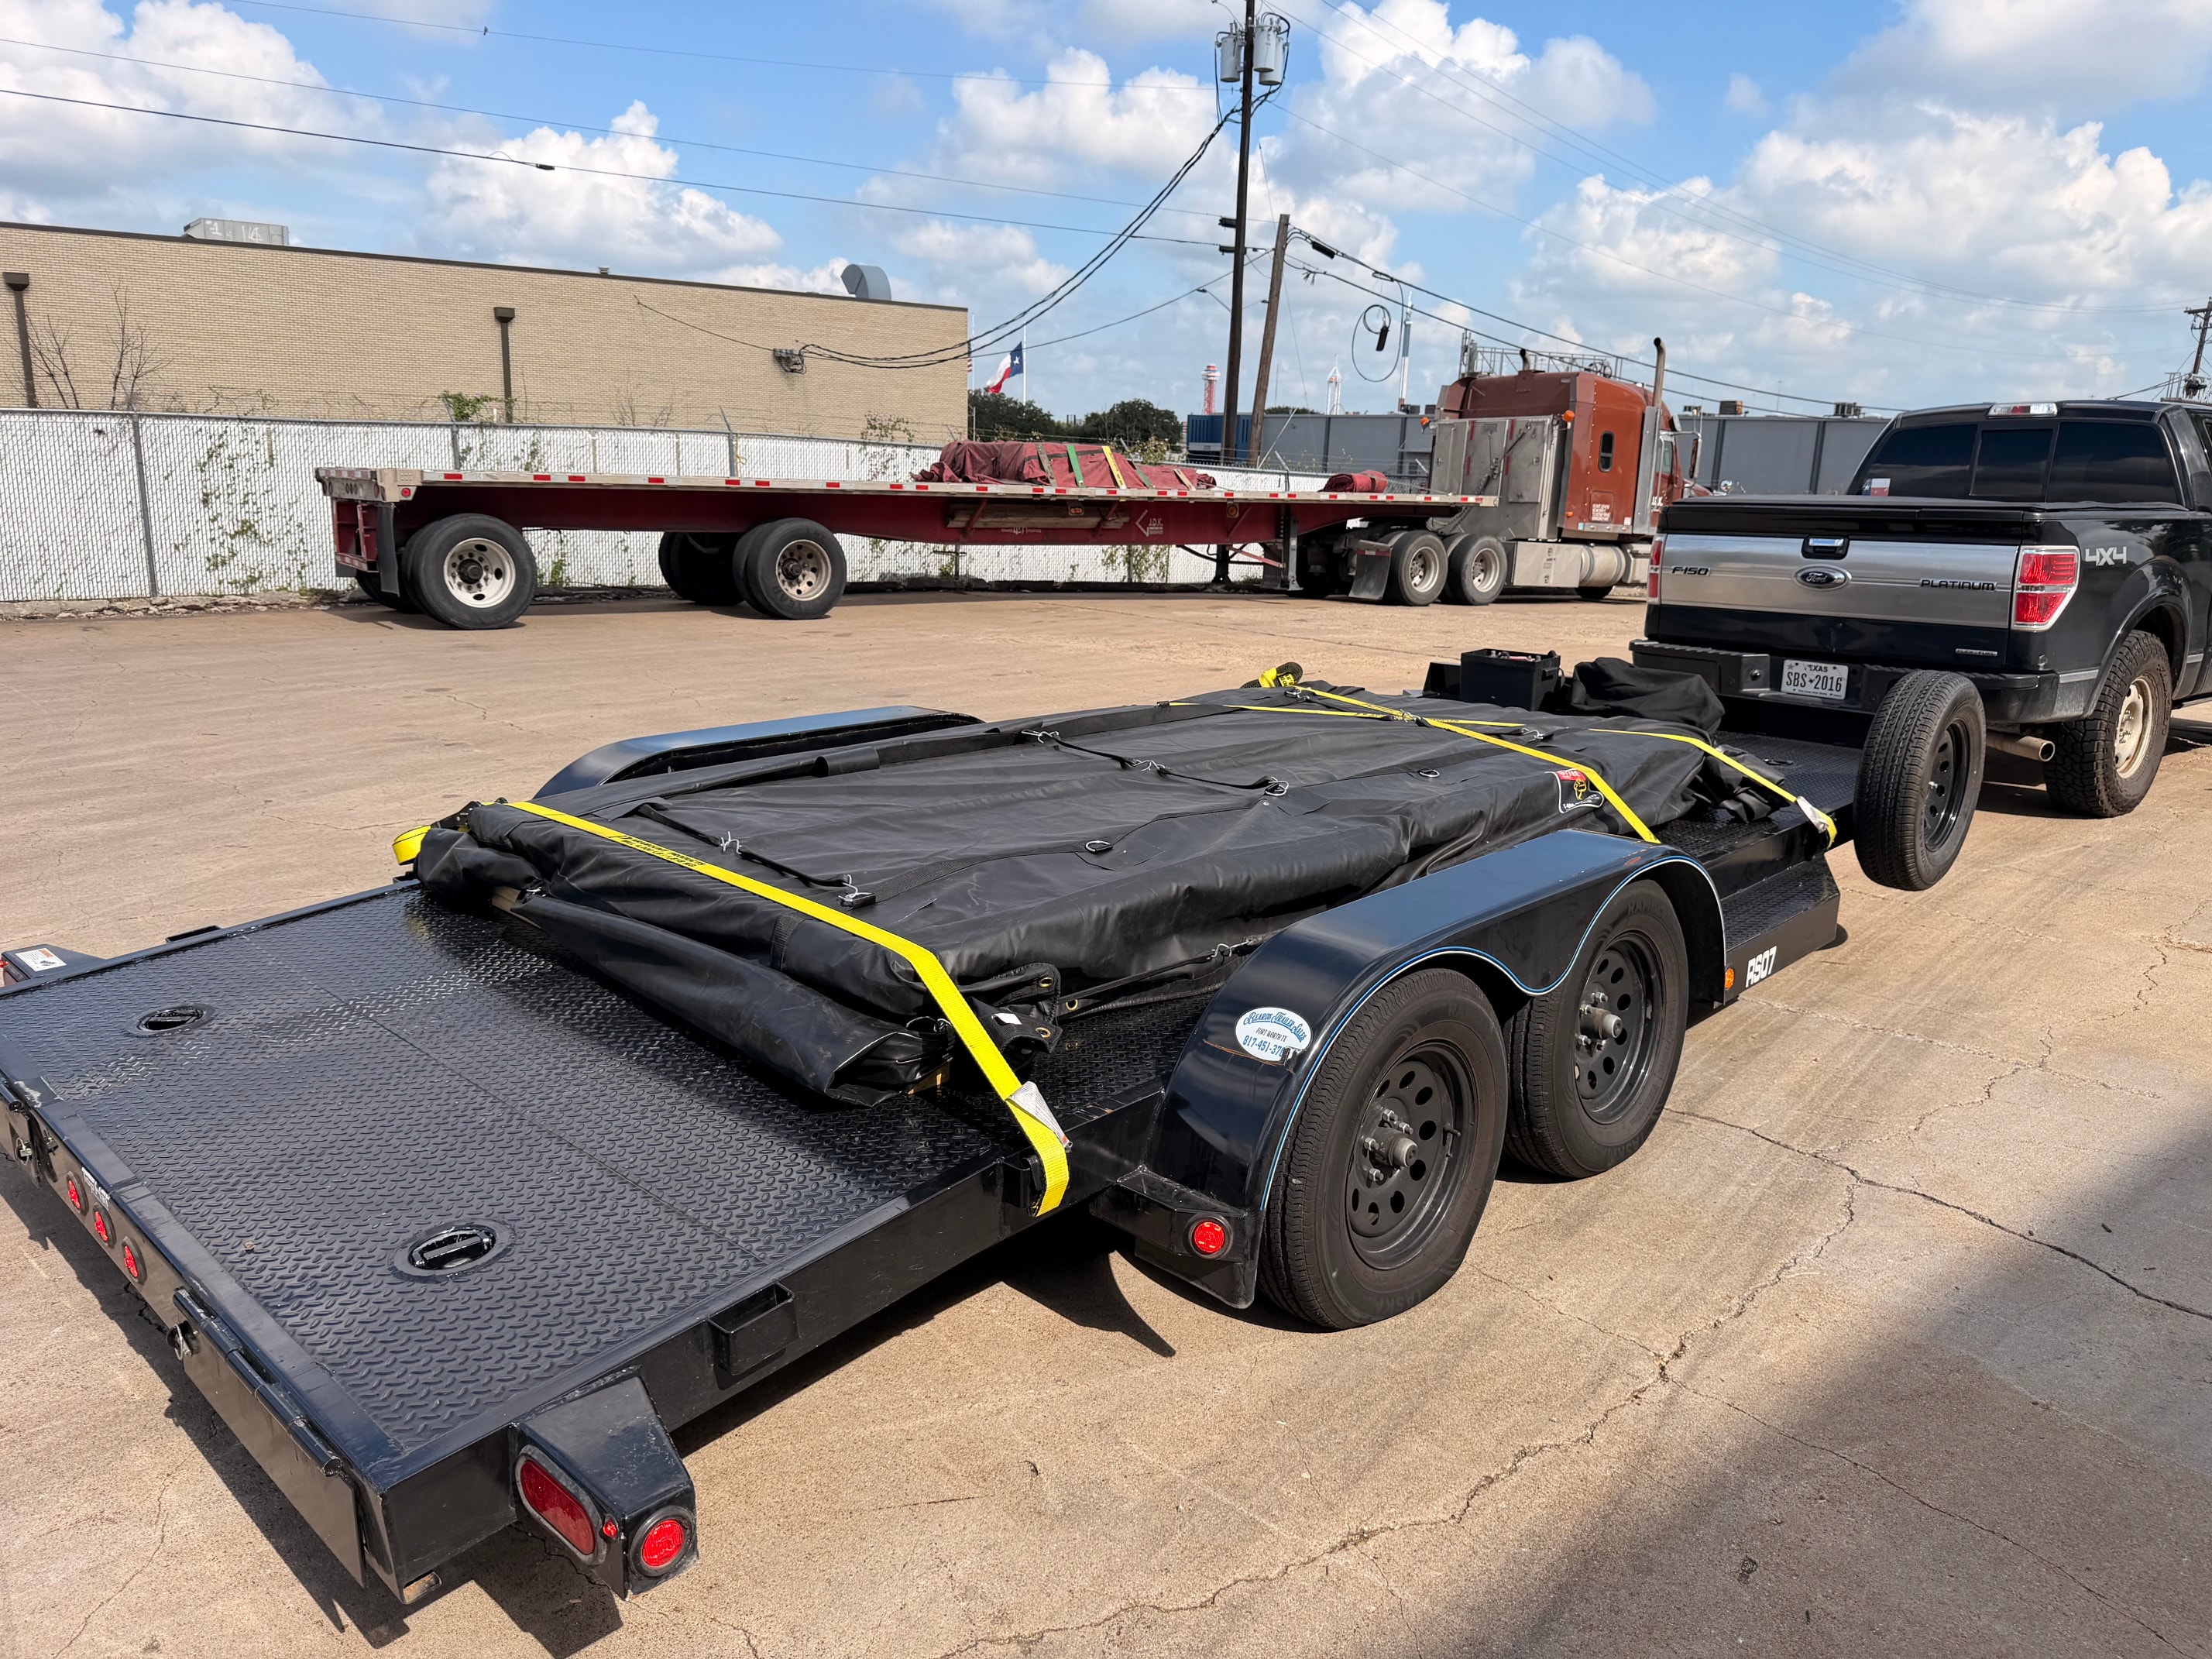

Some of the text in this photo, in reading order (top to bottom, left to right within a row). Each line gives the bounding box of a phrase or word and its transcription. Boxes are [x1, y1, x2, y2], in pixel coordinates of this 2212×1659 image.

[2085, 546, 2128, 567] 4X4
[1671, 566, 1709, 575] F-150
[1805, 572, 1828, 582] Ford
[1920, 579, 1996, 591] PLATINUM
[1786, 672, 1843, 692] SBS 2016
[1271, 1012, 1295, 1032] TRAILER
[1255, 1027, 1268, 1036] FORT
[1267, 1030, 1283, 1042] WORTH
